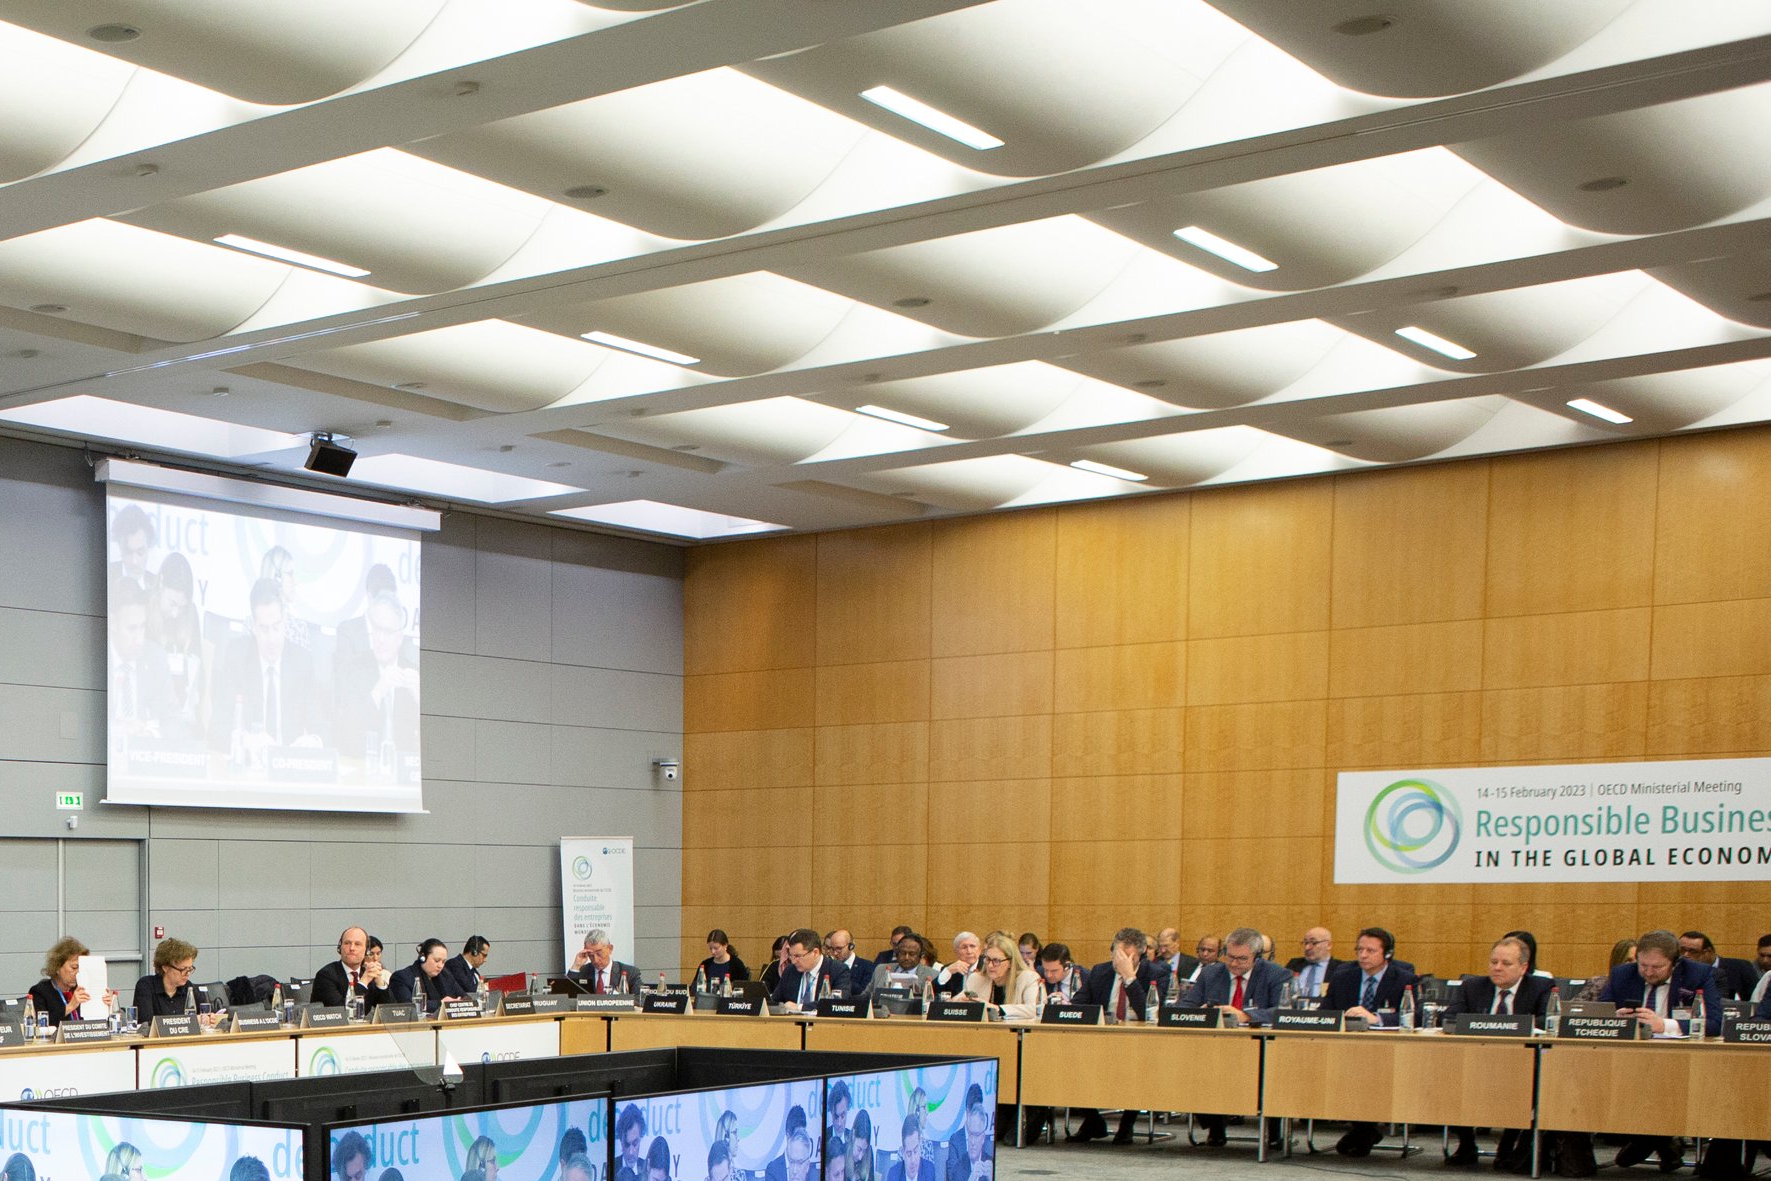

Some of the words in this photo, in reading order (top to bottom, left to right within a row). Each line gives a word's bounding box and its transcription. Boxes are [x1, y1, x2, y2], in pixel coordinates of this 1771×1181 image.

[1510, 784, 1556, 800] February
[1559, 784, 1586, 796] 2023
[1597, 782, 1627, 795] OECD
[1630, 781, 1690, 795] Ministerial
[1694, 779, 1742, 795] Meeting
[1477, 804, 1650, 845] Responsible
[1475, 850, 1499, 868] IN
[1512, 850, 1552, 867] THE
[1564, 848, 1656, 867] GLOBAL
[943, 1008, 968, 1017] SUISSE
[1059, 1010, 1083, 1019] SUEDE
[163, 1017, 191, 1025] PRESIDENT
[1171, 1013, 1206, 1023] SLOVENIE
[1279, 1015, 1336, 1025] ROYAUME-UNI
[1568, 1018, 1627, 1028] REPUBLIQUE
[1469, 1020, 1519, 1031] ROUMANIE
[1575, 1028, 1619, 1038] TCHEQUE
